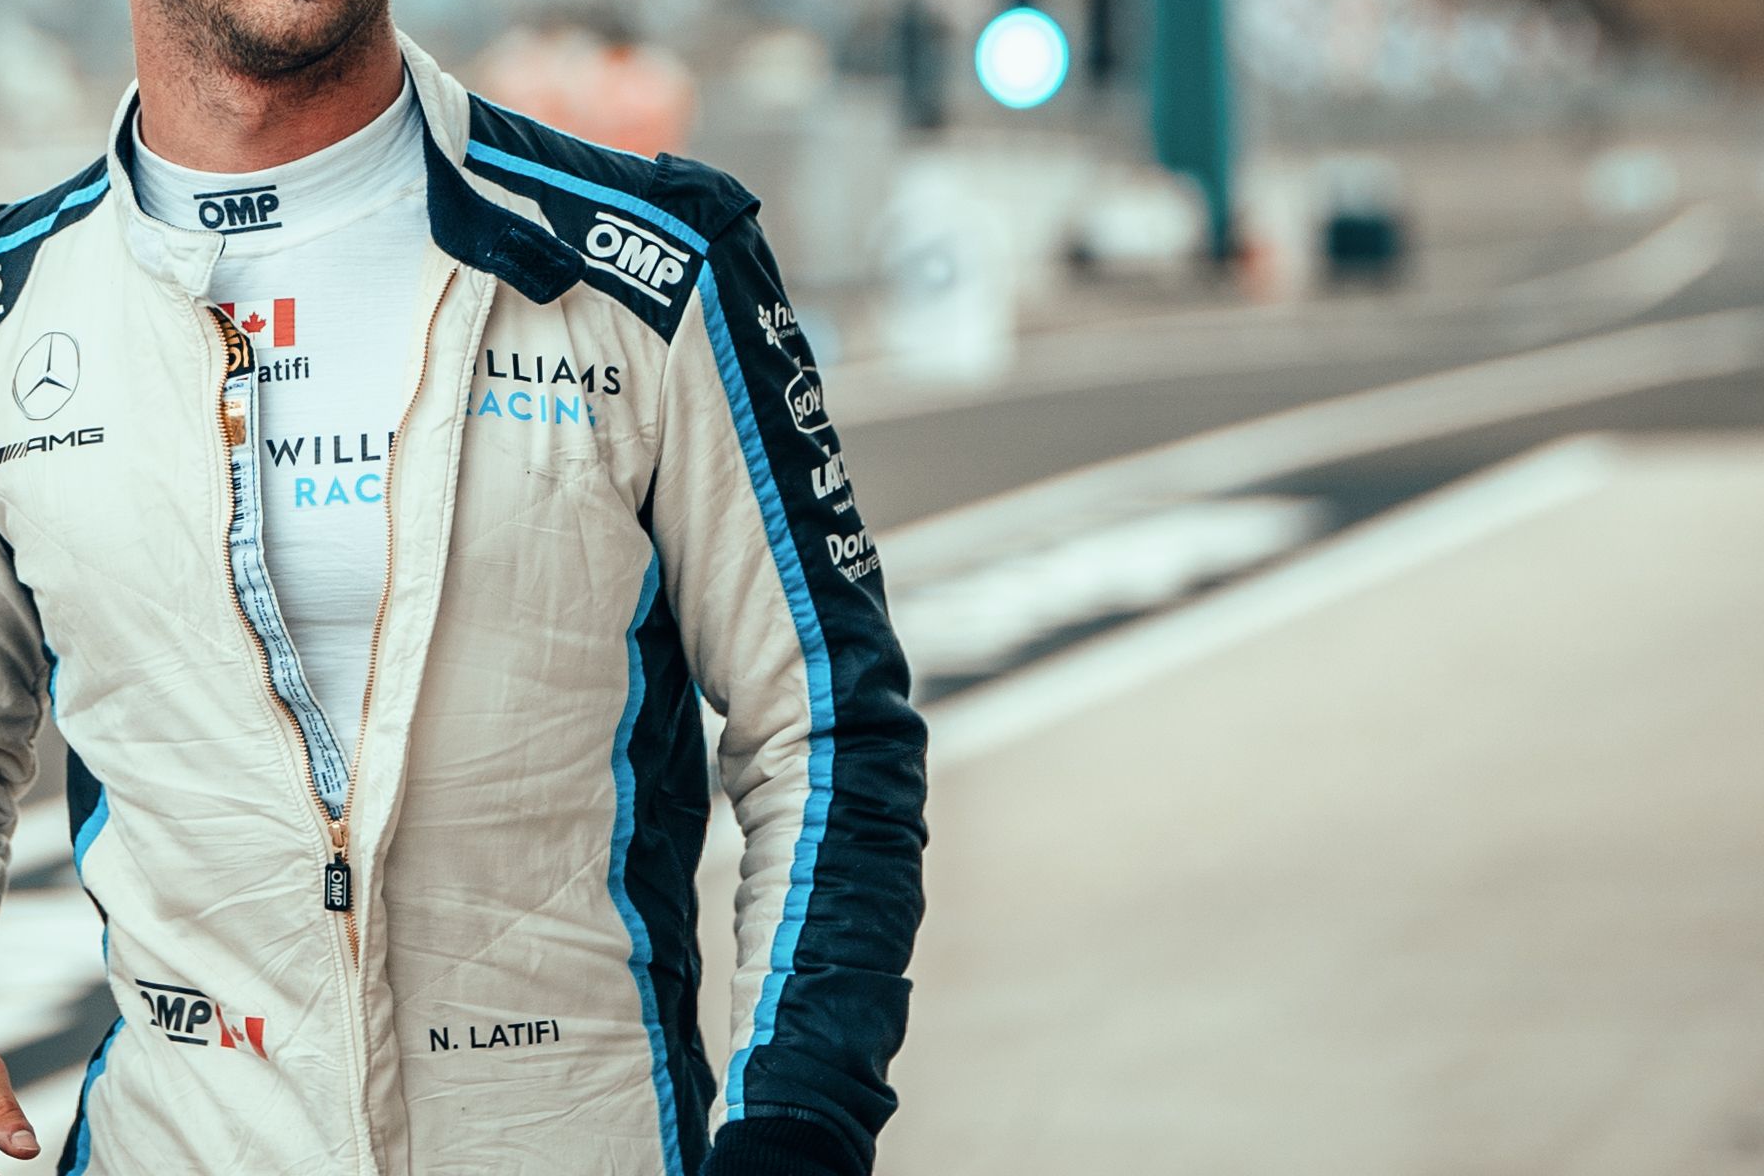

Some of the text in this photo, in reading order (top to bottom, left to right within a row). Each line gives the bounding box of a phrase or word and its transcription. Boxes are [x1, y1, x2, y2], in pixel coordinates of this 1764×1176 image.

[199, 193, 279, 229] OMP
[586, 223, 684, 288] OMP
[473, 349, 621, 395] LLIAMS
[24, 427, 104, 456] AMG
[295, 473, 382, 508] RAC
[331, 870, 343, 906] OMP
[429, 1019, 559, 1052] N. LATIFI
